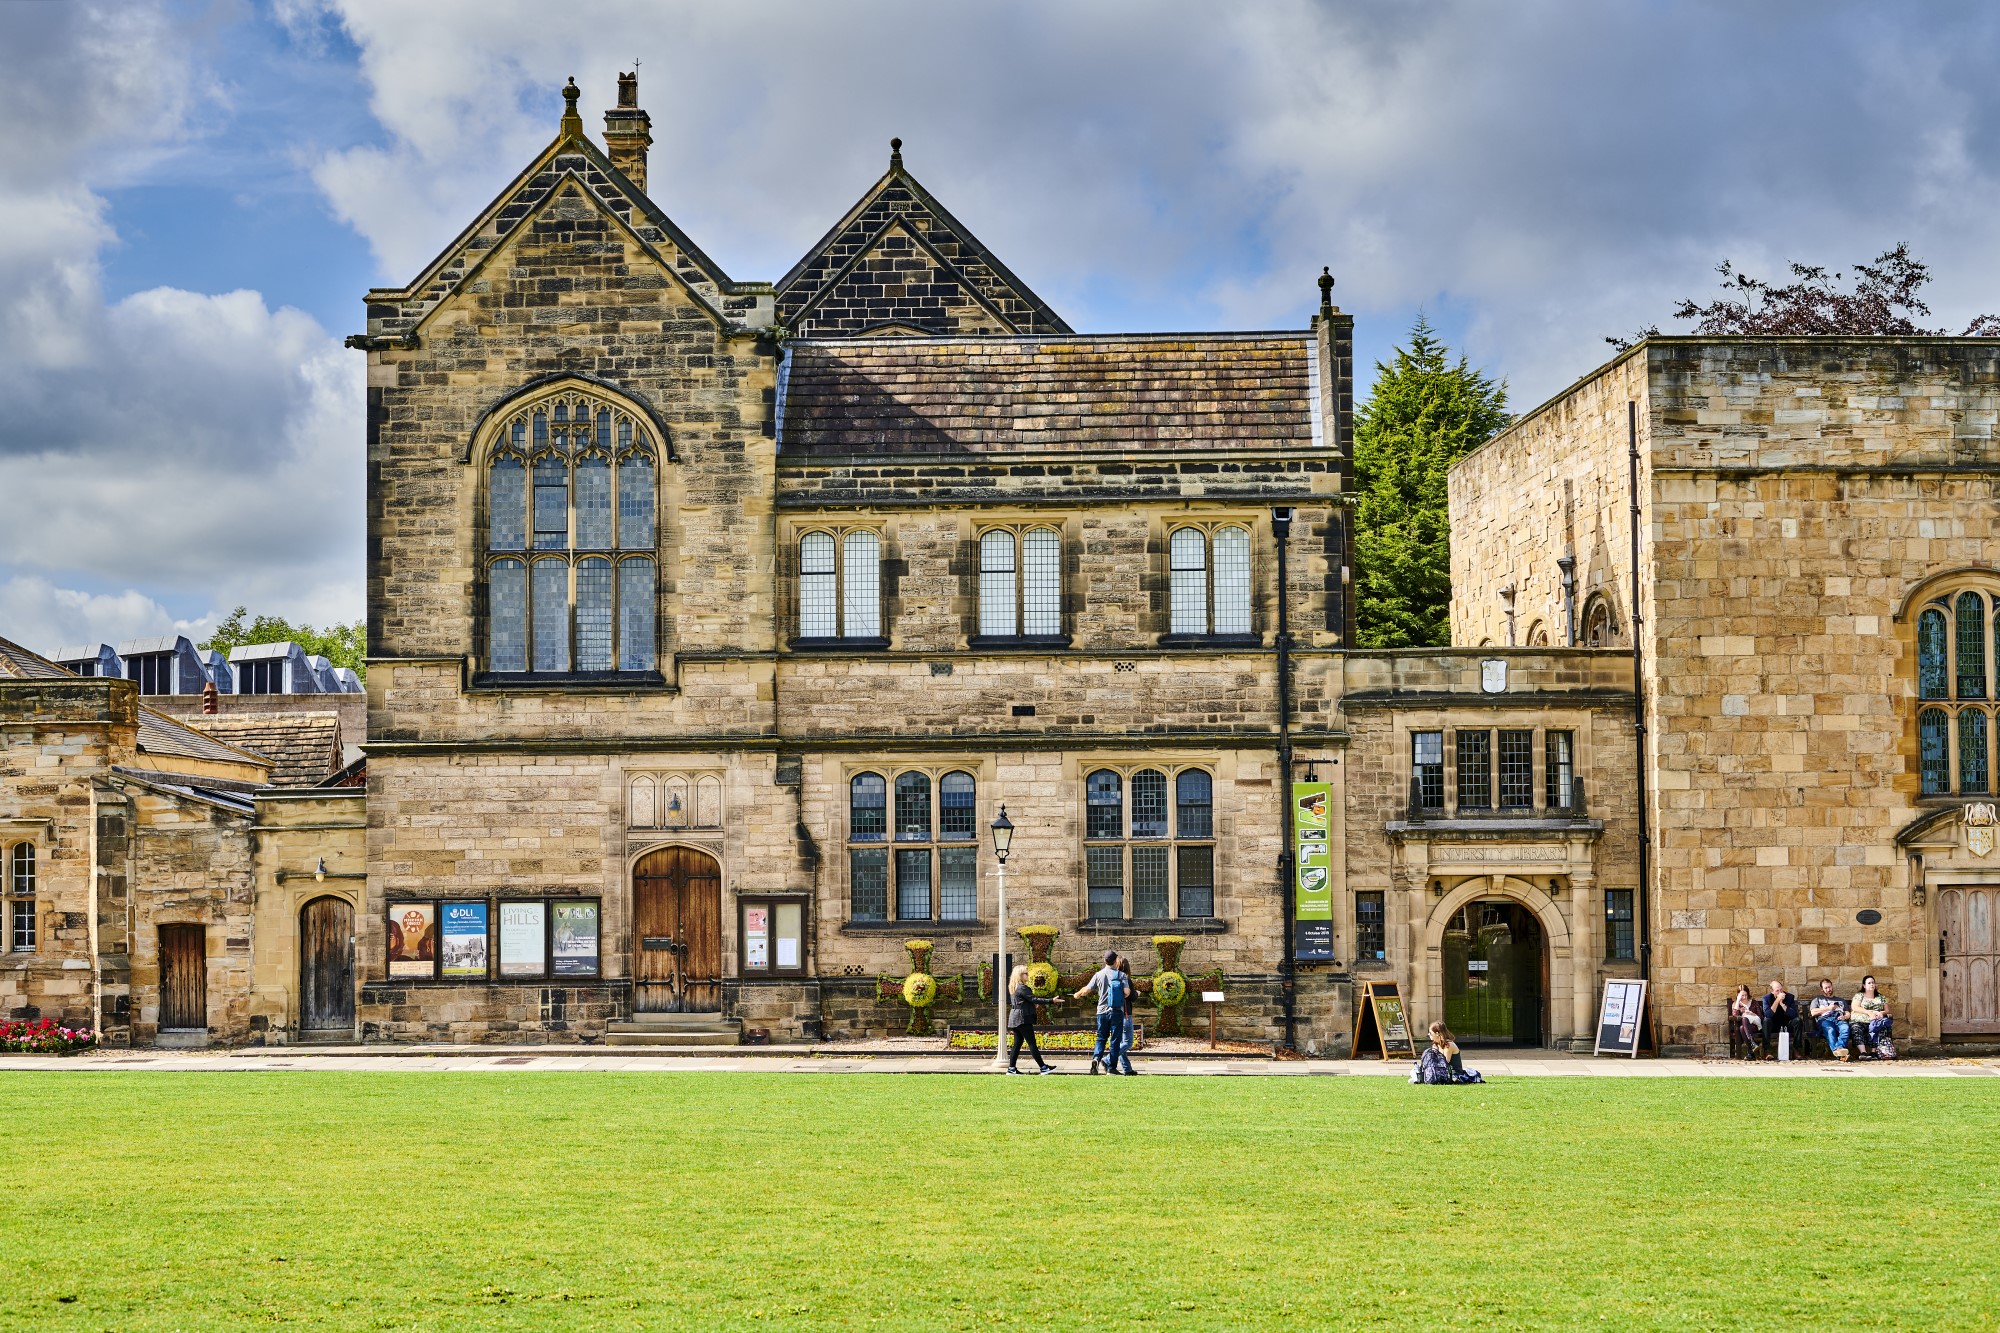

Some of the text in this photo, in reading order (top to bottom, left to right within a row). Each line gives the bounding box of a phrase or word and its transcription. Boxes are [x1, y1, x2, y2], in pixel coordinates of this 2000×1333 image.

[1298, 792, 1327, 892] WILD
[1432, 847, 1566, 860] UNIVERSITY LIBRARY
[460, 908, 472, 916] DLI
[504, 908, 533, 916] LIVING
[556, 907, 596, 920] WILD
[504, 914, 540, 926] HILLS
